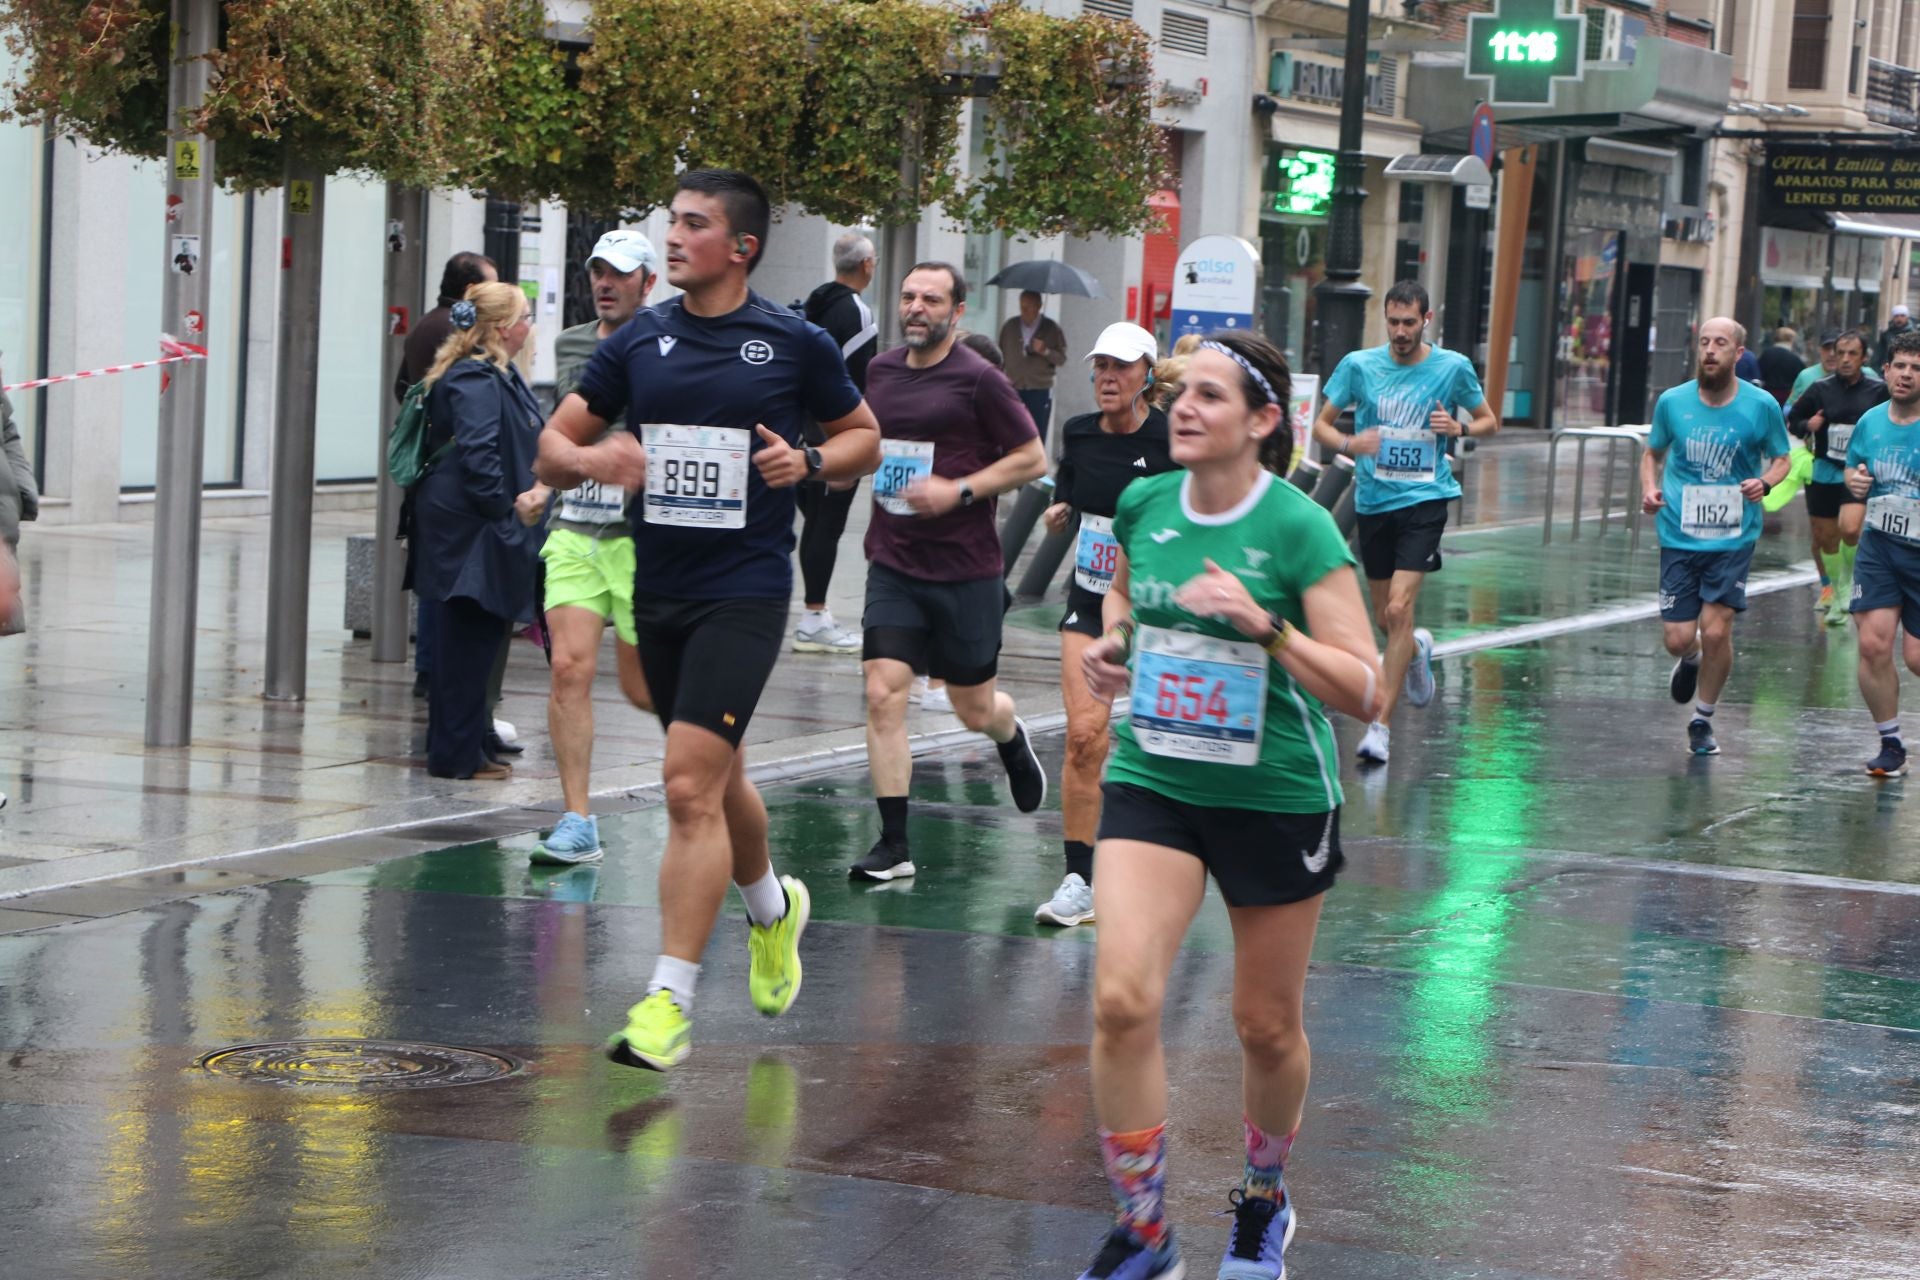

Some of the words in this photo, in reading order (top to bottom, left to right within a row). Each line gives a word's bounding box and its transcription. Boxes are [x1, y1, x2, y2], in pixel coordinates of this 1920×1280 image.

[1772, 156, 1827, 170] OPTICA
[1834, 157, 1885, 172] Emilia
[1774, 175, 1847, 188] APARATOS
[1851, 177, 1888, 189] PARA
[1785, 192, 1836, 205] LENTES
[1842, 193, 1861, 205] DE
[1866, 194, 1920, 207] CONTAC
[1198, 259, 1236, 273] alsa
[1388, 446, 1422, 467] 553
[664, 459, 720, 498] 899
[1696, 504, 1729, 524] 1152
[1881, 512, 1910, 535] 1151
[1154, 671, 1230, 725] 654
